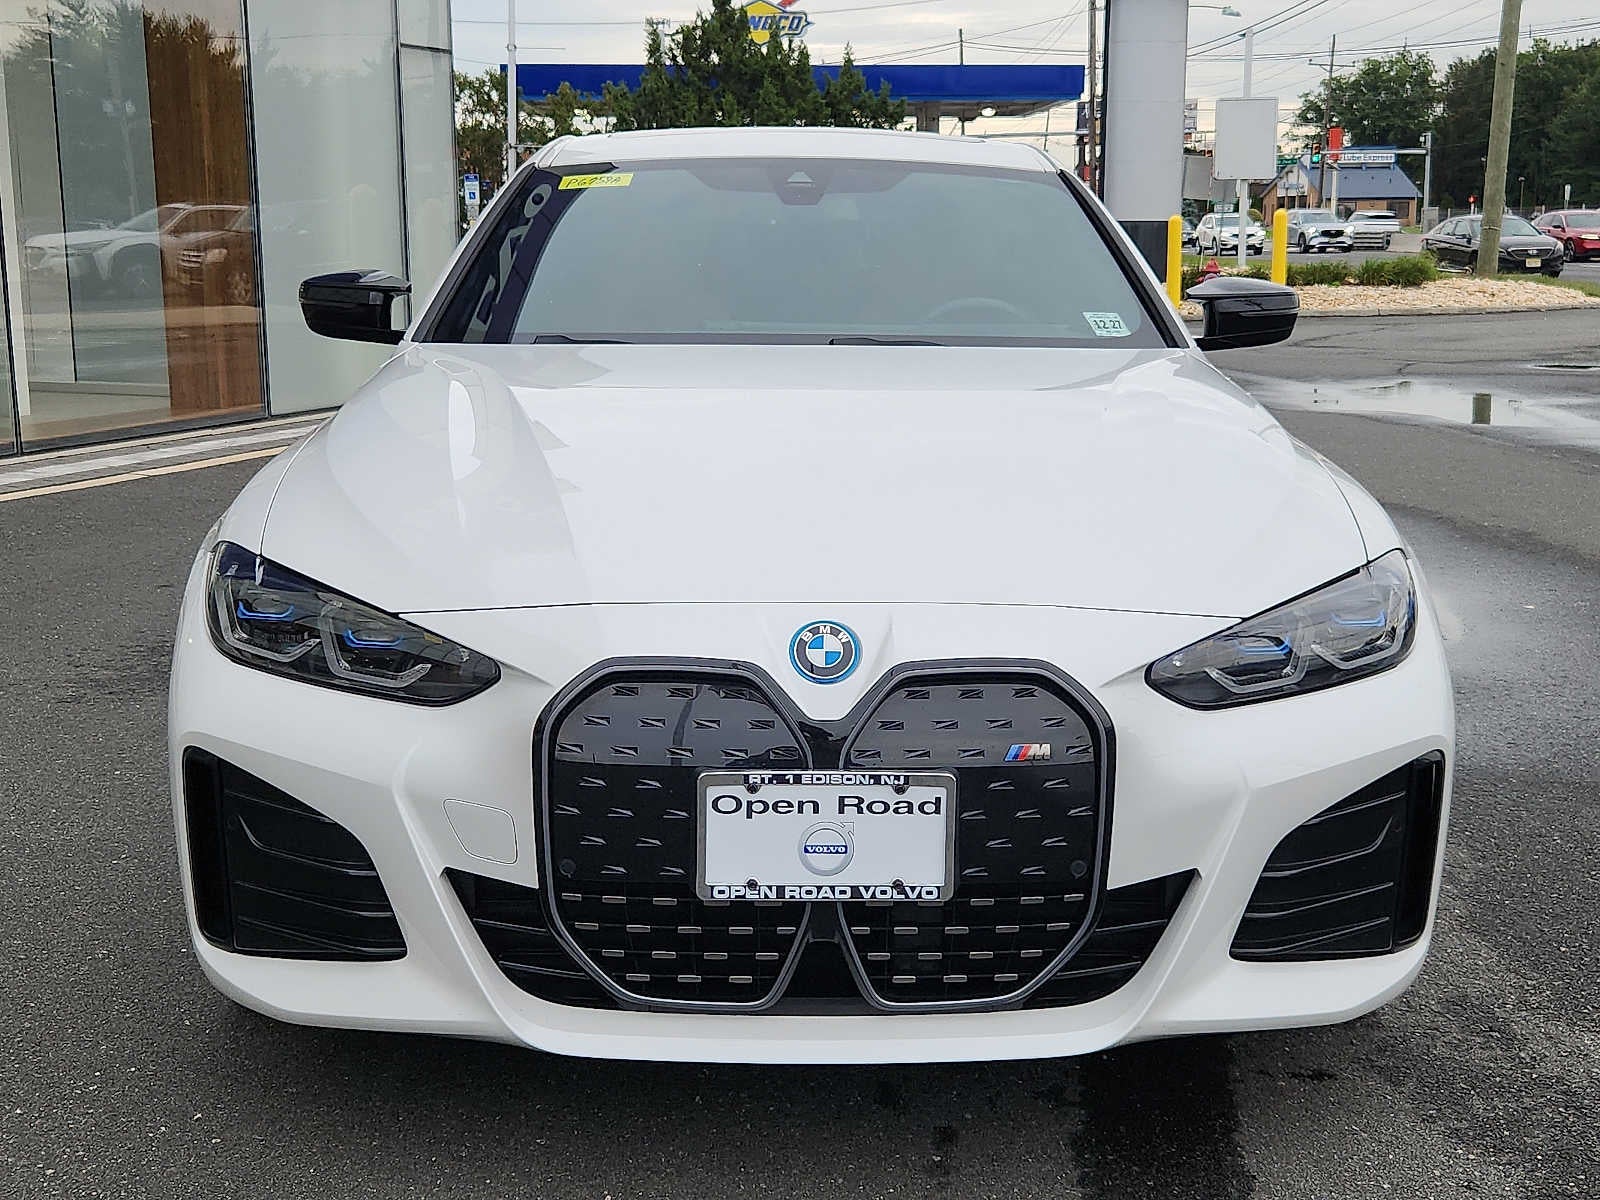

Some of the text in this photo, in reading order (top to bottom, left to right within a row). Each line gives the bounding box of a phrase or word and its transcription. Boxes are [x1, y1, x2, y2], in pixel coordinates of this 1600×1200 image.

[801, 625, 850, 643] BMW
[785, 774, 794, 784] 1
[801, 774, 875, 786] EDISON,
[880, 775, 905, 786] NJ
[711, 794, 942, 819] Open Road
[806, 845, 846, 853] VOLVO
[712, 885, 939, 900] OPEN ROAD VOLVO
